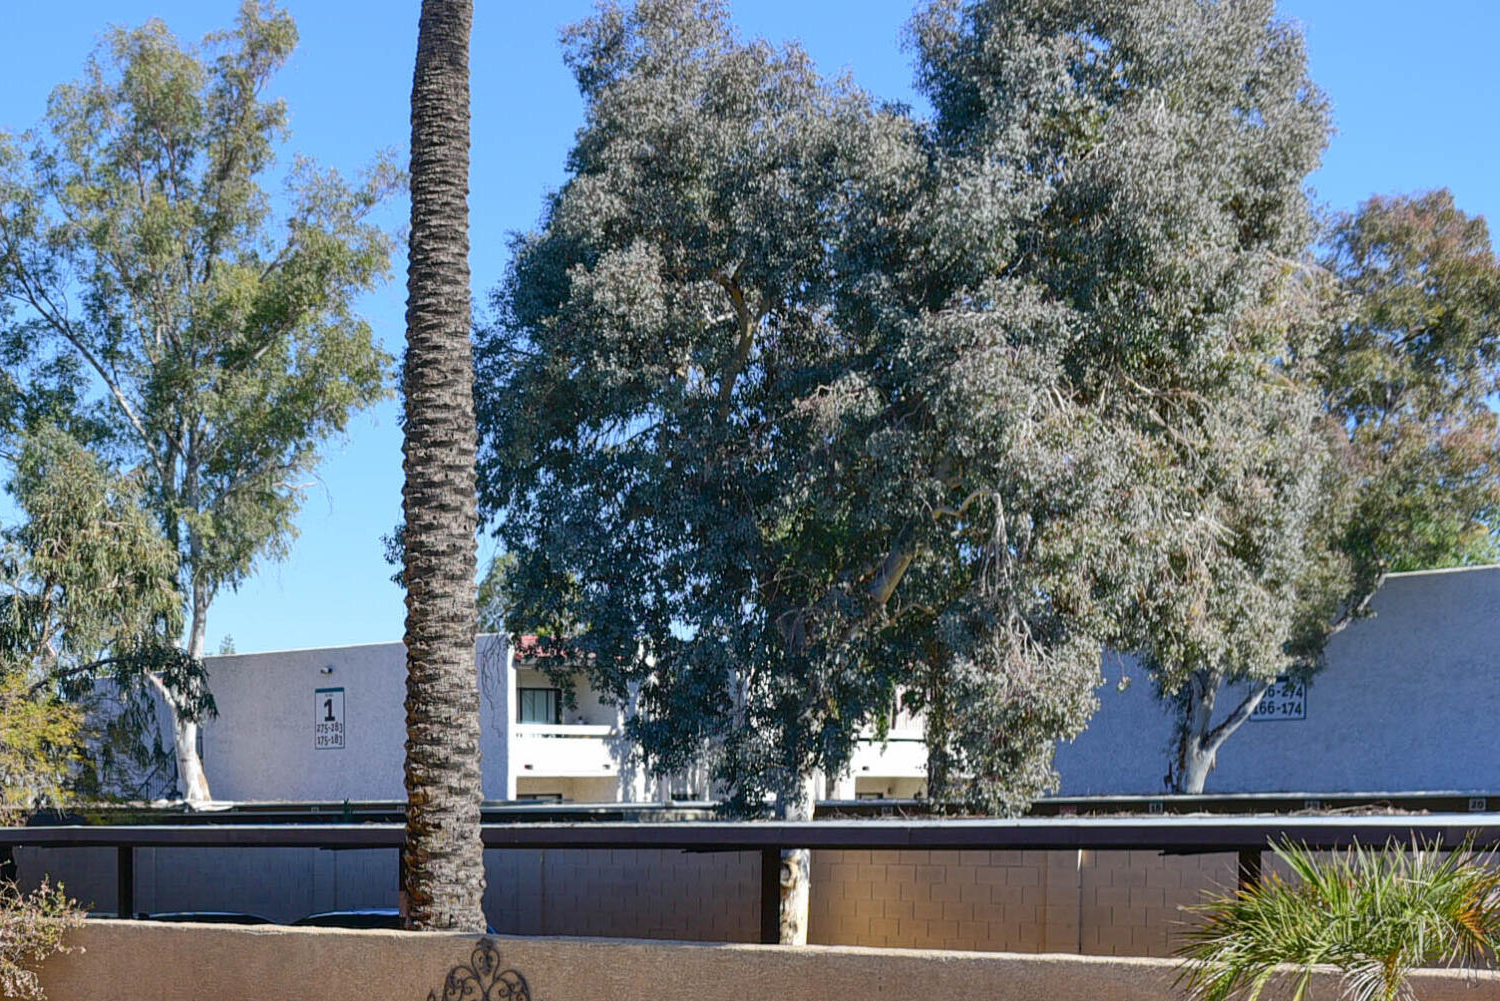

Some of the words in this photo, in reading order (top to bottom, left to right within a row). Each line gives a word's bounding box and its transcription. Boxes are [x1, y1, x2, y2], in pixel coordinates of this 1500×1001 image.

[324, 699, 335, 721] 1
[316, 722, 343, 734] 275-283
[317, 734, 343, 746] 175-183
